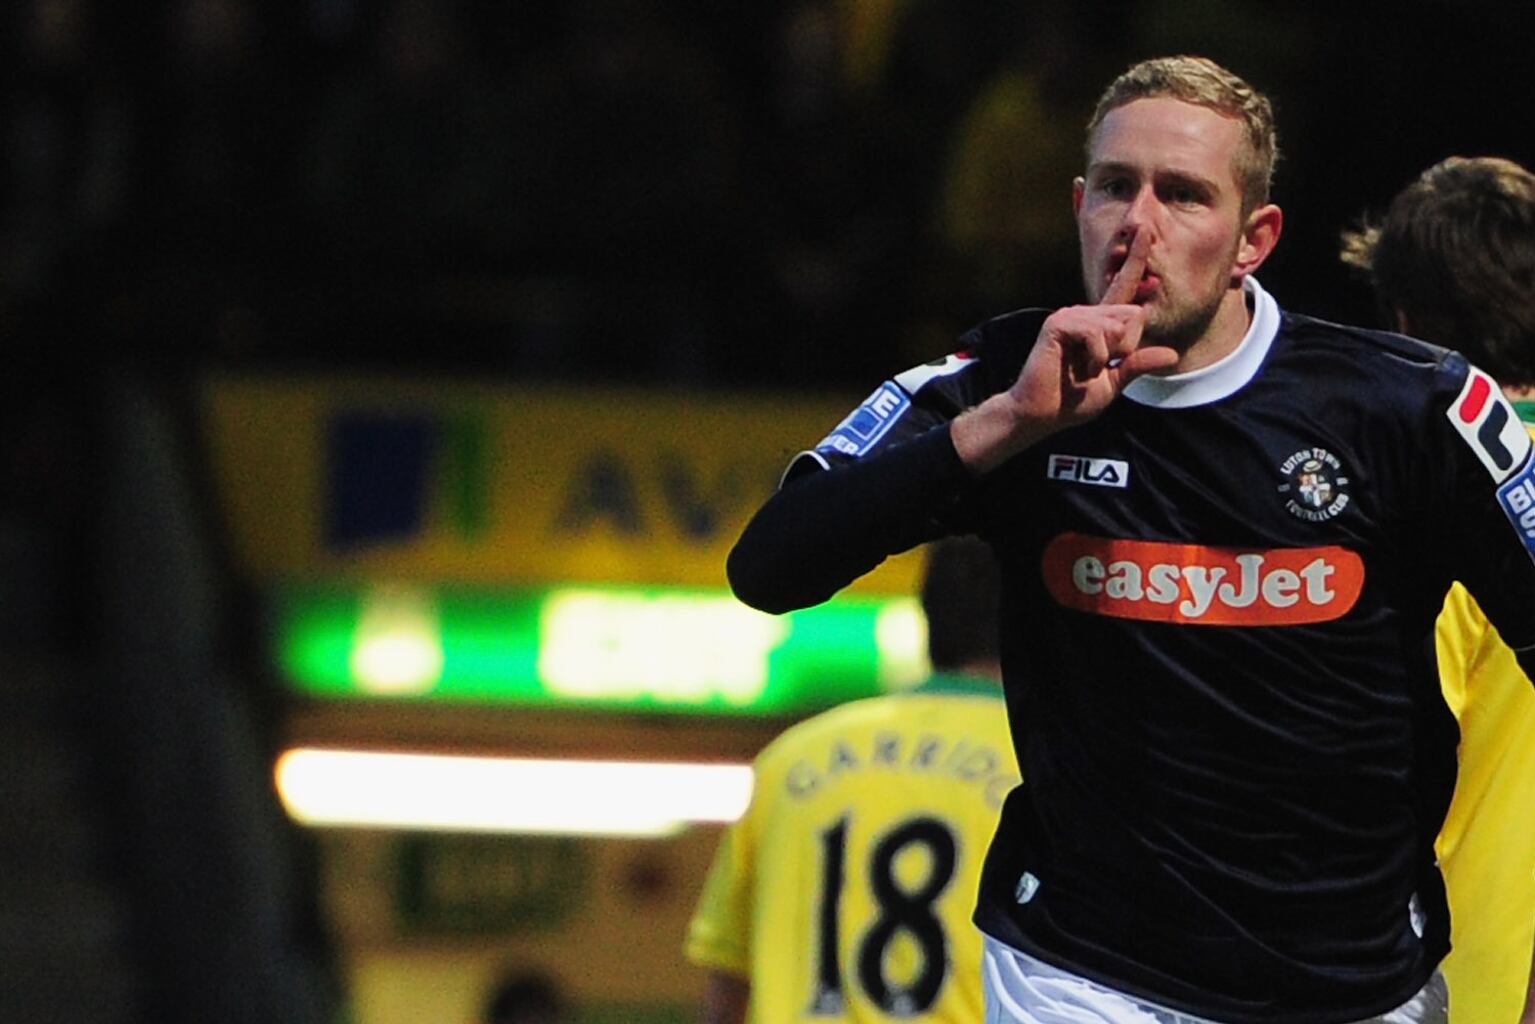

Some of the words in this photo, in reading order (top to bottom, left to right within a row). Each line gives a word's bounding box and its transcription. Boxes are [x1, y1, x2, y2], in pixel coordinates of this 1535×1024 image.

[1053, 458, 1120, 483] FILA
[1072, 553, 1336, 618] easyJet
[806, 810, 960, 1020] 18
